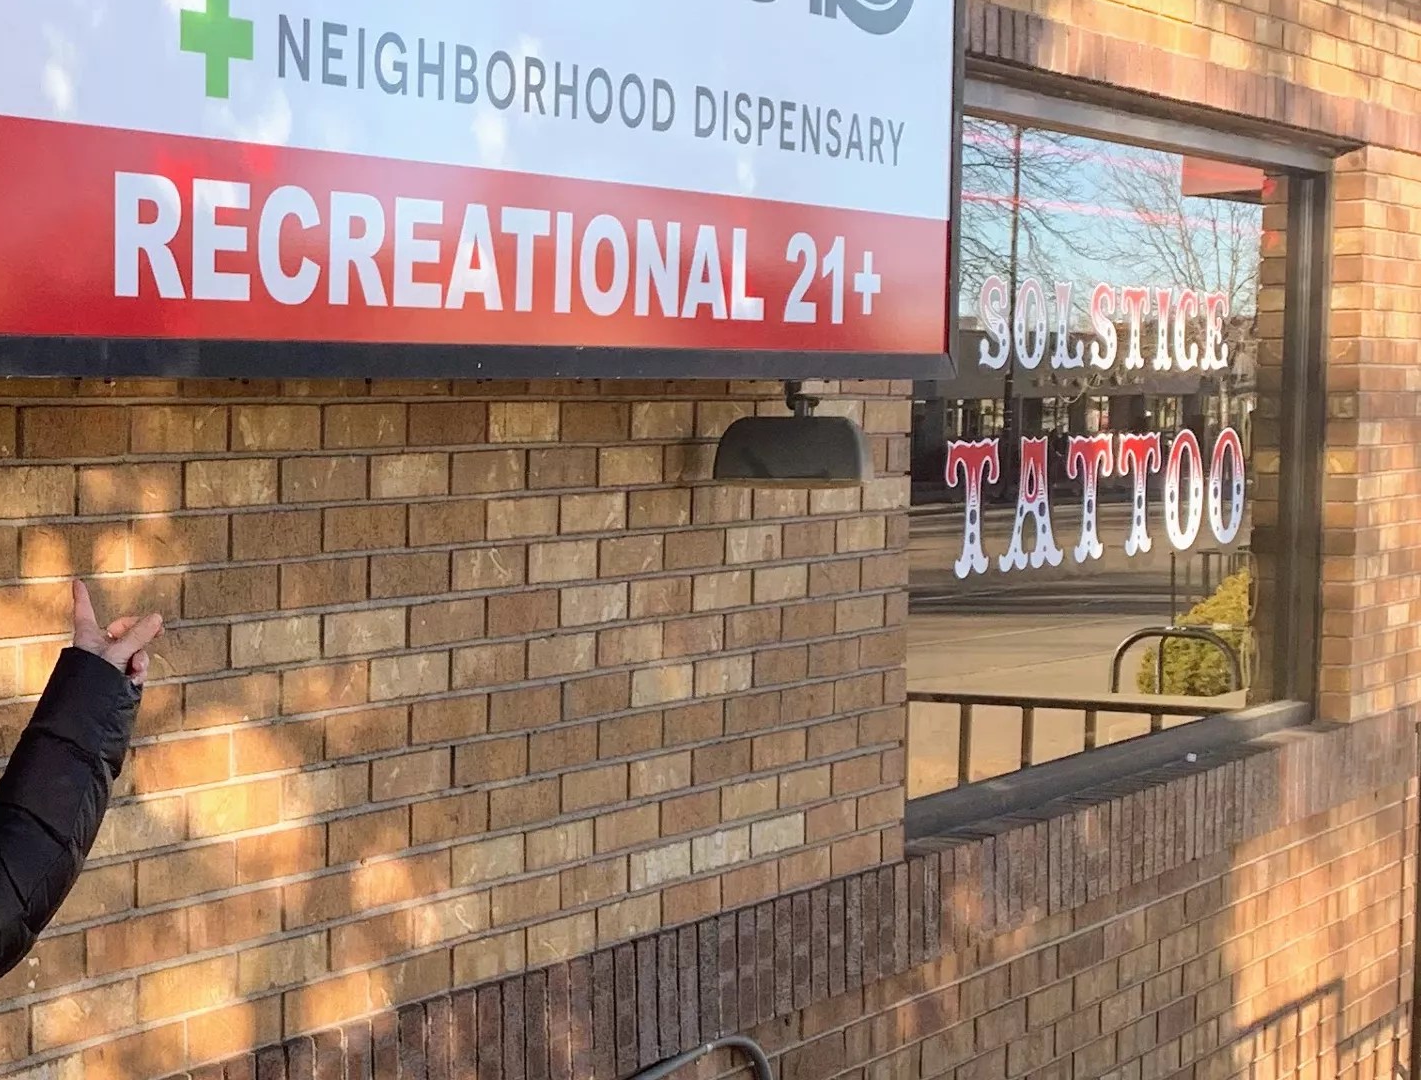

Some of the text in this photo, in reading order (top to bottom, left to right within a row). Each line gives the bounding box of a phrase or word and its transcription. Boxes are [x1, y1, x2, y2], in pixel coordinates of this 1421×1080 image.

[277, 13, 905, 168] NEIGHBORHOOD DISPENSARY
[113, 171, 882, 325] RECREATIONAL 21+
[978, 275, 1231, 372] SOLSTICE
[944, 426, 1247, 580] TATTOO
